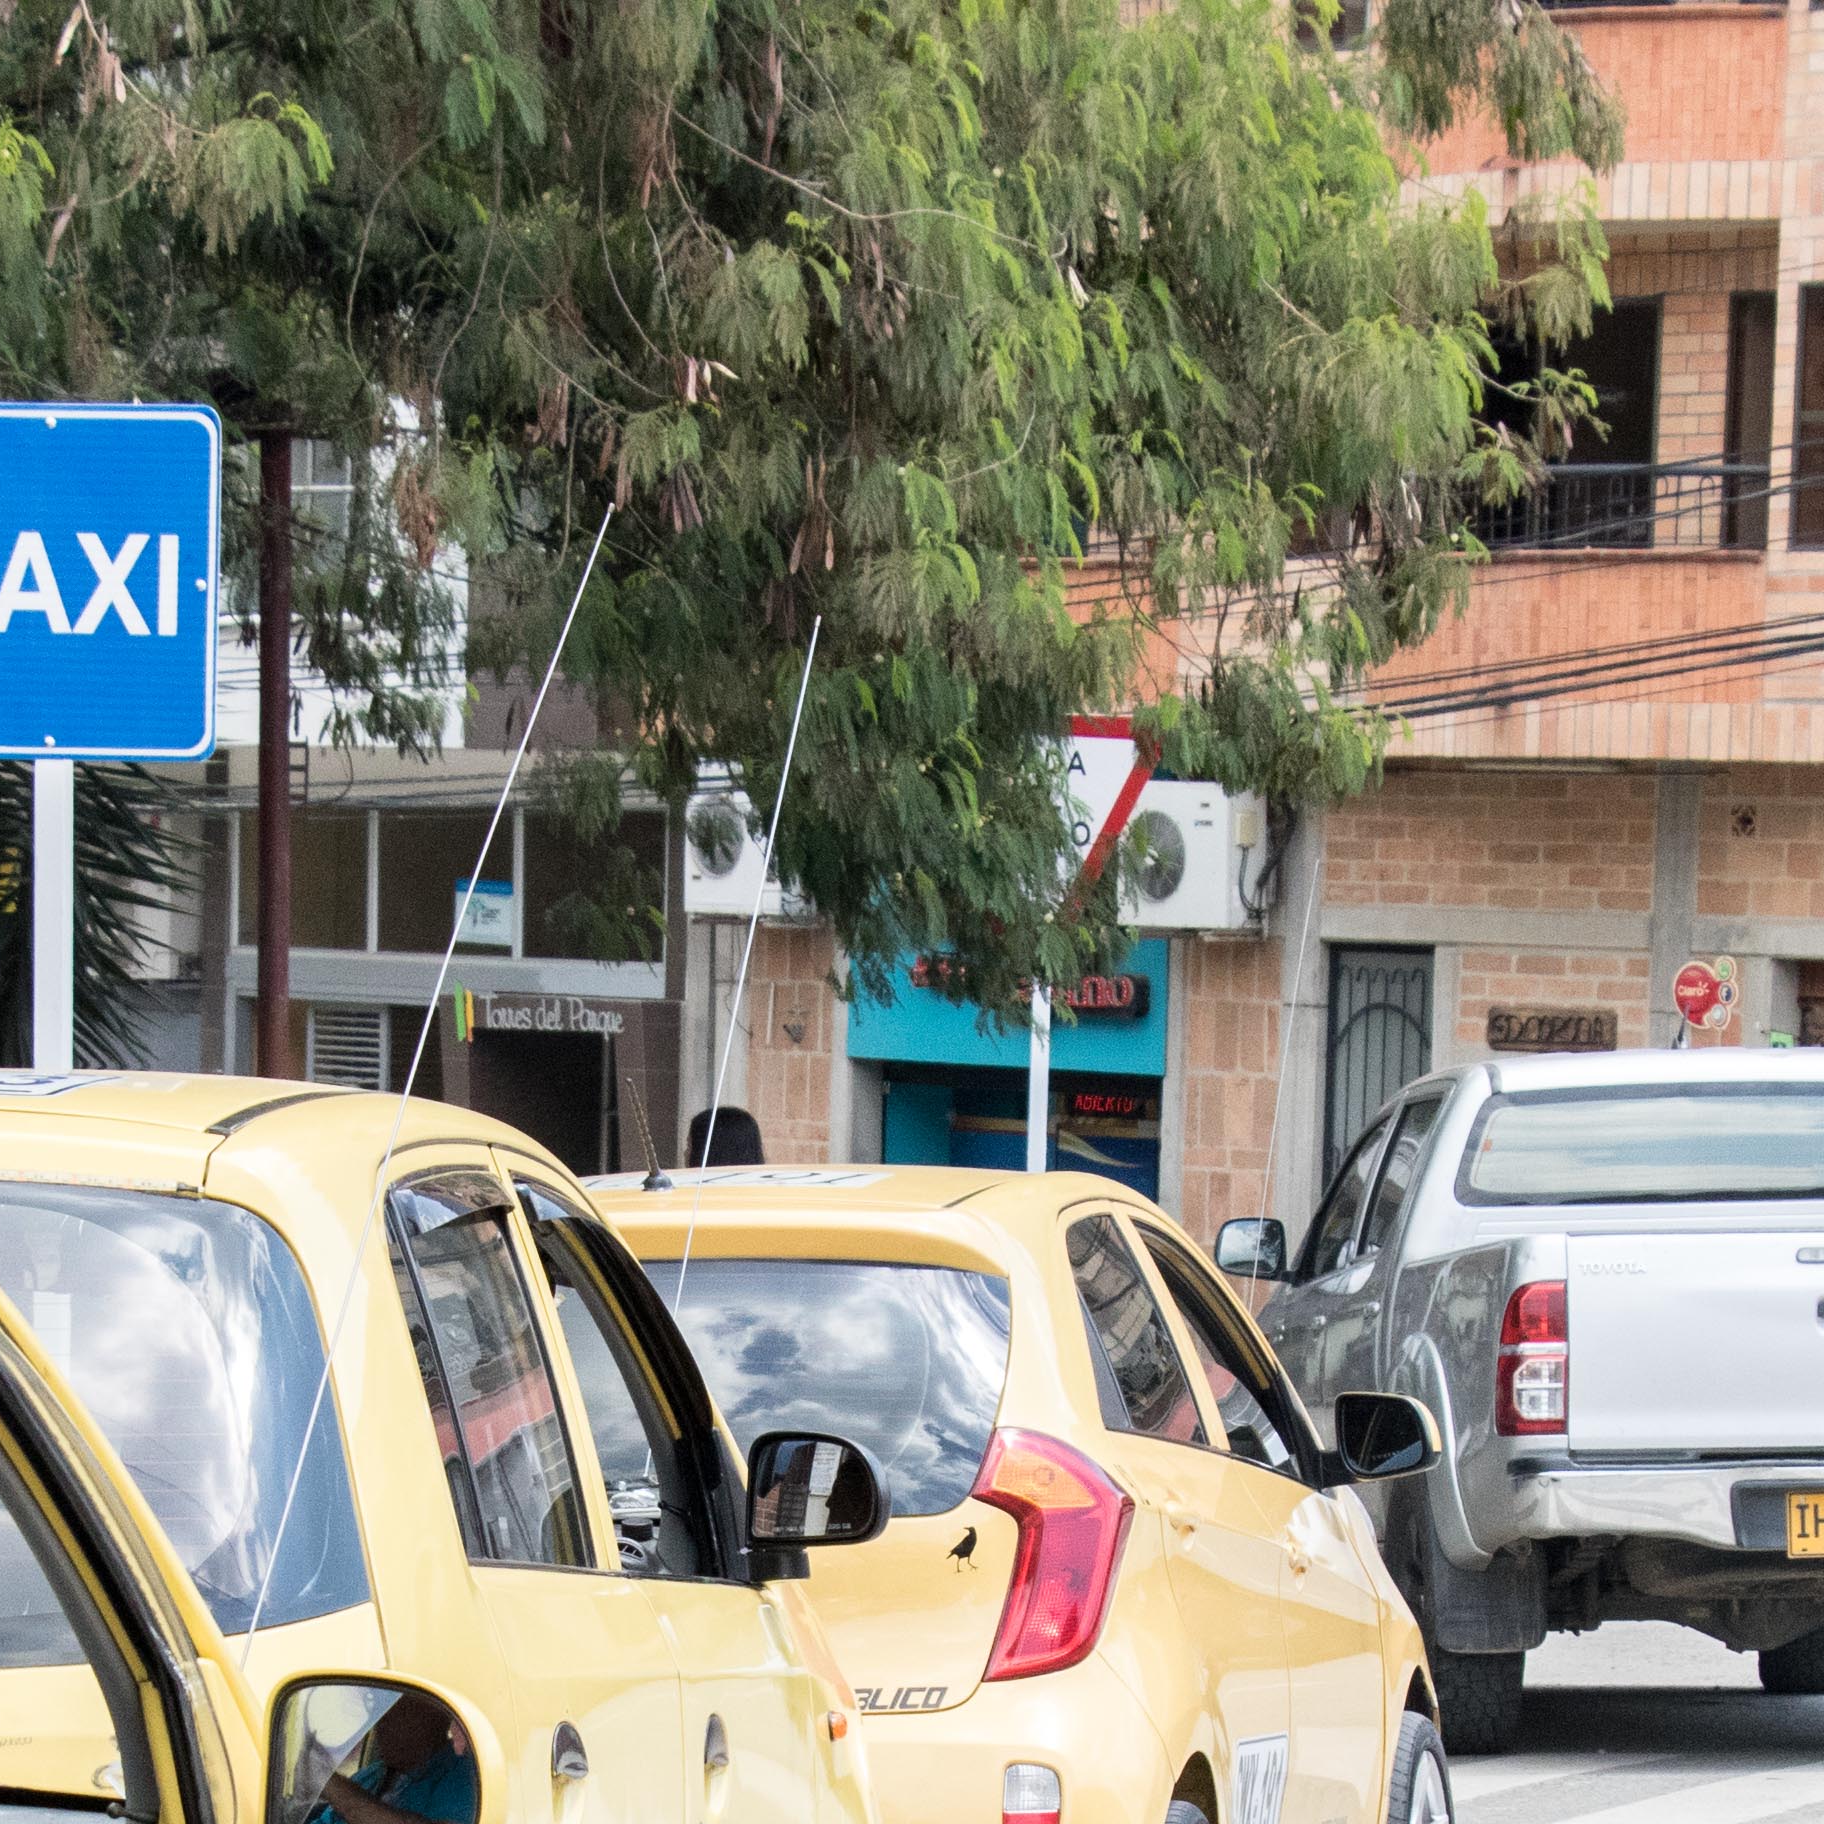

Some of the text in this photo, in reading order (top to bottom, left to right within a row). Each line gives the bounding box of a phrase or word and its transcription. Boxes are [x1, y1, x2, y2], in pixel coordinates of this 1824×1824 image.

[1677, 984, 1704, 997] Claro
[478, 991, 625, 1041] Torres del Parque
[1577, 1263, 1648, 1276] TOYOTA
